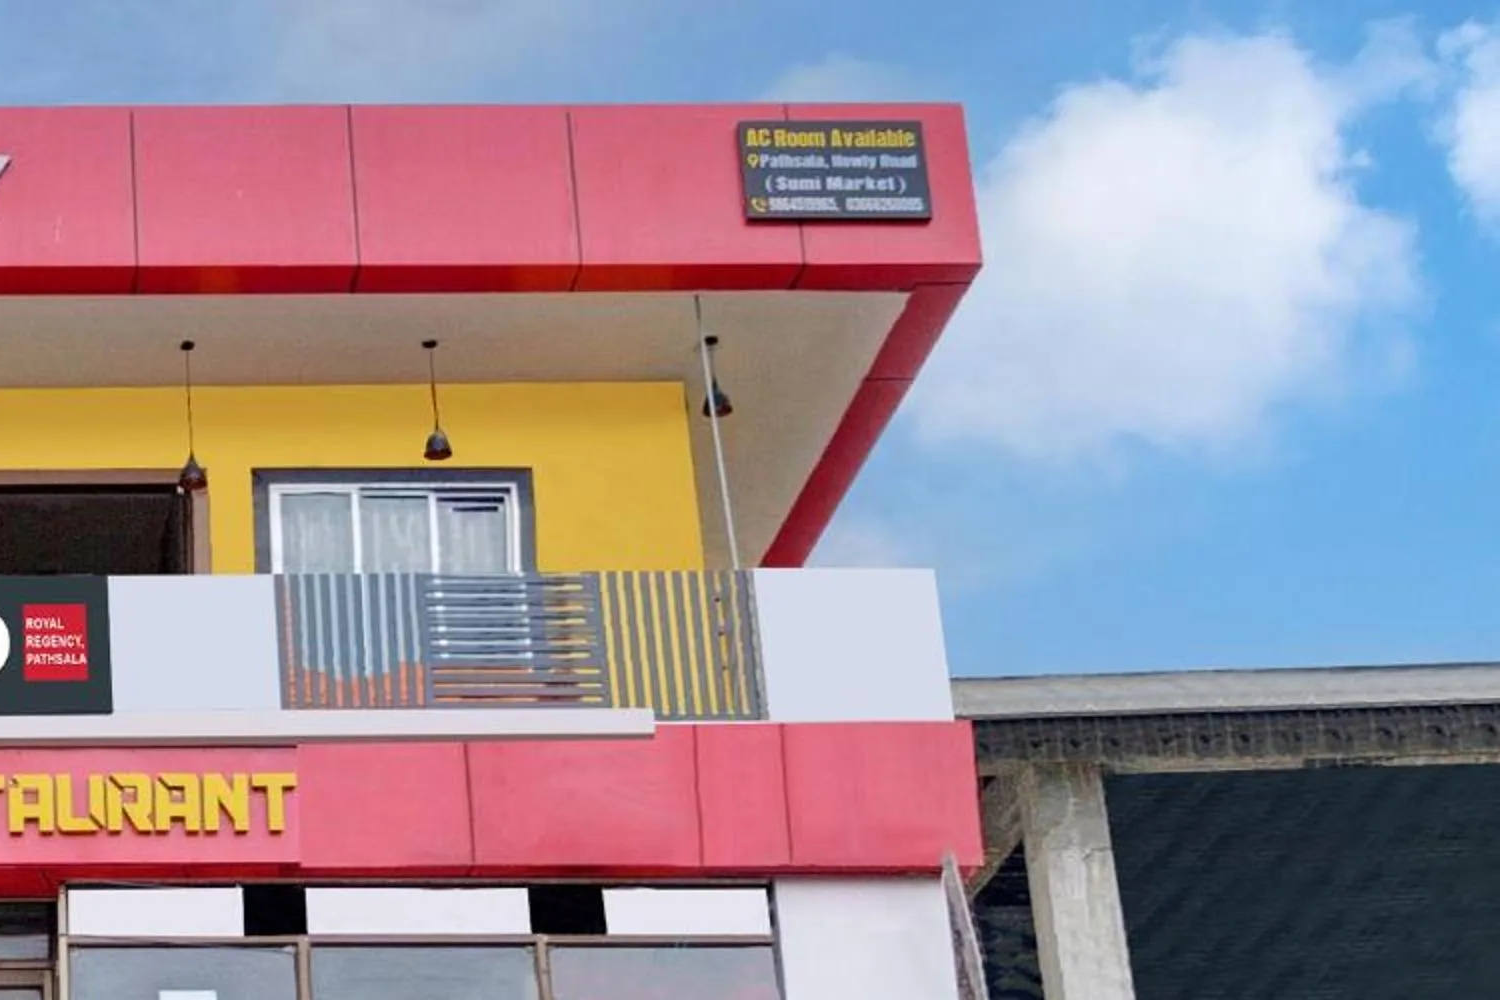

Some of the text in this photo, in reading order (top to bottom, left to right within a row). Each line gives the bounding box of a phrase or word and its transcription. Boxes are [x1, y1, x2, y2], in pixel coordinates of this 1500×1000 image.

[774, 129, 826, 147] Room
[830, 129, 915, 148] Available
[25, 617, 65, 630] ROYAL
[25, 635, 85, 649] REGENCY,
[25, 653, 88, 665] PATHSALA
